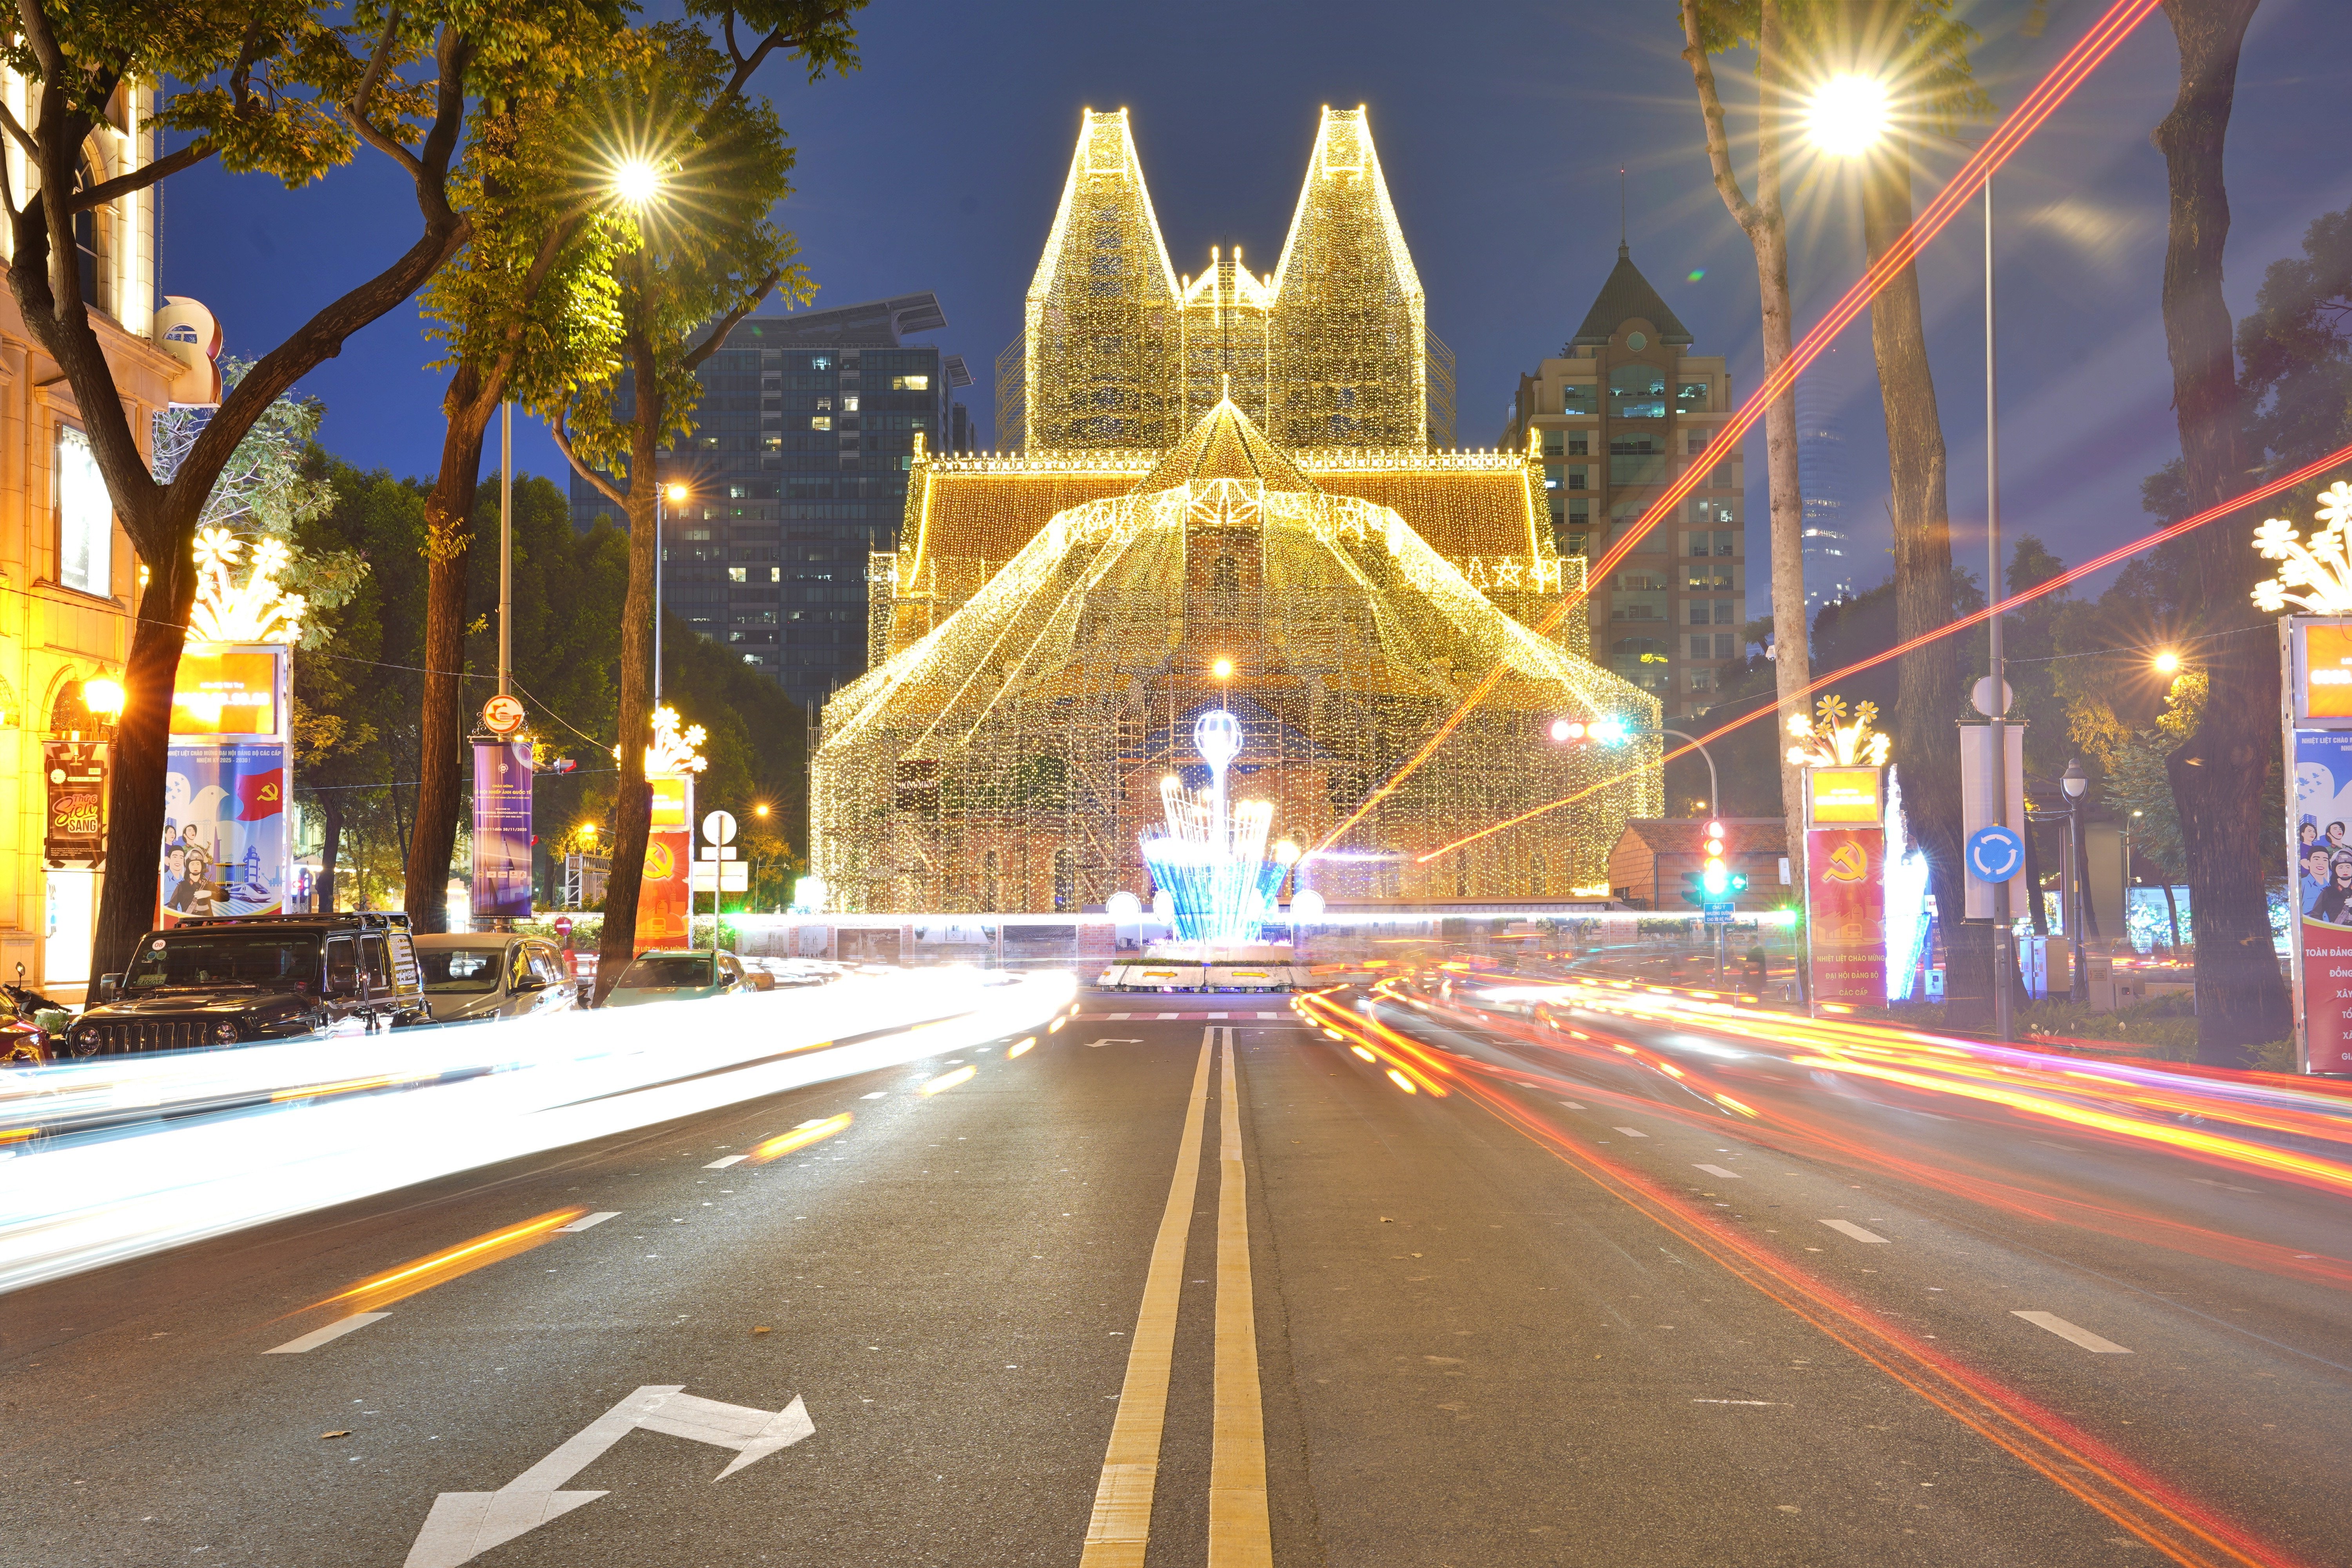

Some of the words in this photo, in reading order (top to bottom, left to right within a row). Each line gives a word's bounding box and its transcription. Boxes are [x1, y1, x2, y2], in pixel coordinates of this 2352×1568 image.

[2301, 737, 2318, 745] NHIỆT
[69, 820, 96, 831] SANG
[2306, 947, 2328, 956] TOÀN
[2330, 946, 2352, 956] ĐẢNG
[1817, 954, 1834, 964] NHIỆT
[1836, 954, 1846, 964] LIỆT
[1868, 953, 1885, 962] MỪNG
[1826, 973, 1837, 981] ĐẠI
[1838, 971, 1849, 980] HỘI
[1851, 970, 1869, 978] ĐẢNG
[1871, 971, 1879, 980] BỘ
[1855, 987, 1868, 996] CẤP
[2341, 1051, 2352, 1060] GI
